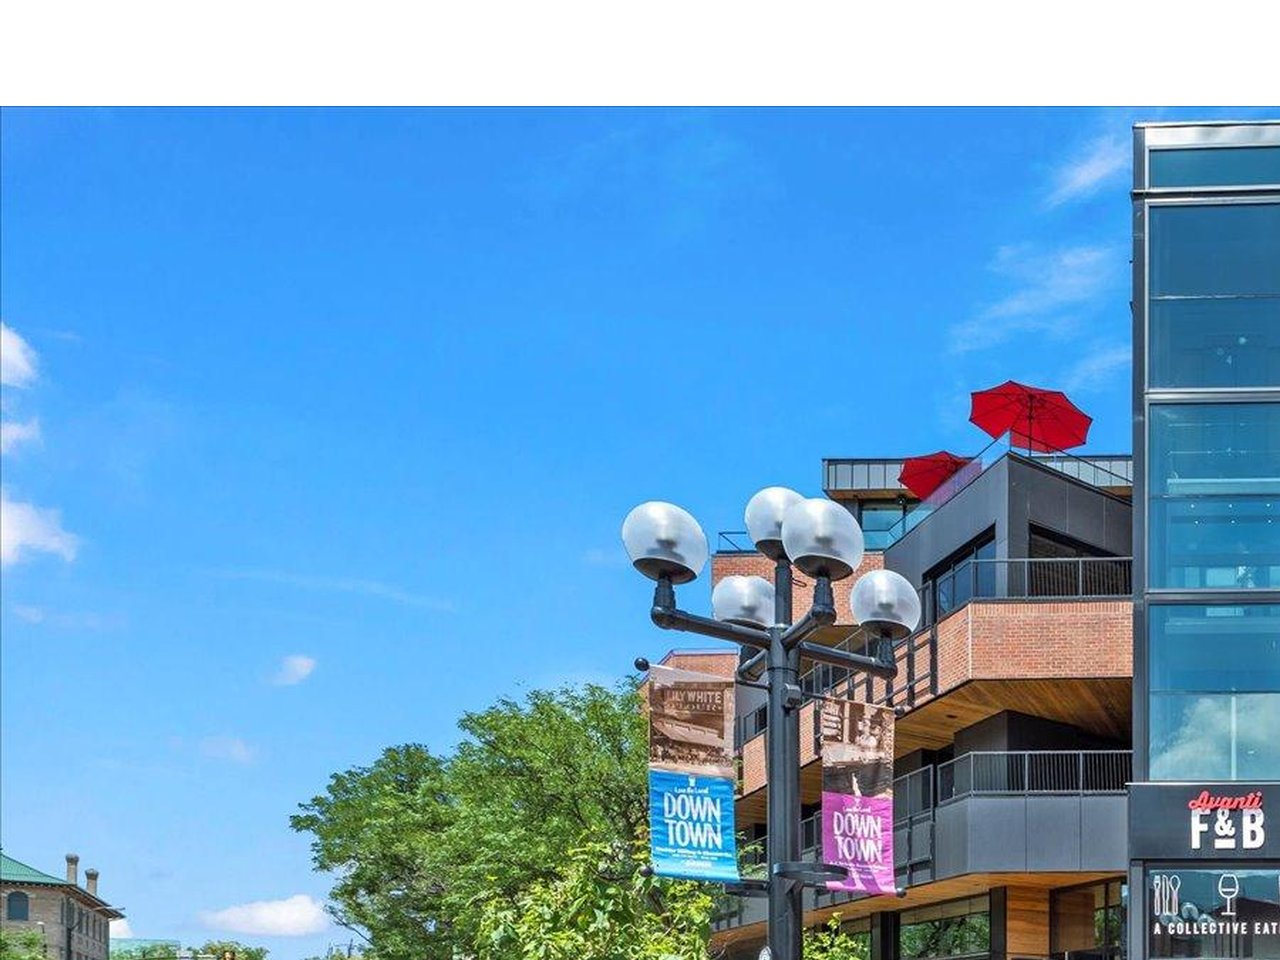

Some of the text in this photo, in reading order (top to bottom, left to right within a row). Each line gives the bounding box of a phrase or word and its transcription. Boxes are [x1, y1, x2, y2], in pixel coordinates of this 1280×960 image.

[687, 691, 722, 703] WHITE
[663, 793, 721, 823] DOWN
[1188, 790, 1263, 811] Avanti
[664, 819, 723, 849] TOWN
[833, 811, 882, 838] DOWN
[834, 836, 883, 863] TOWN
[1153, 922, 1161, 935] A
[1168, 922, 1248, 935] COLLECTIVE
